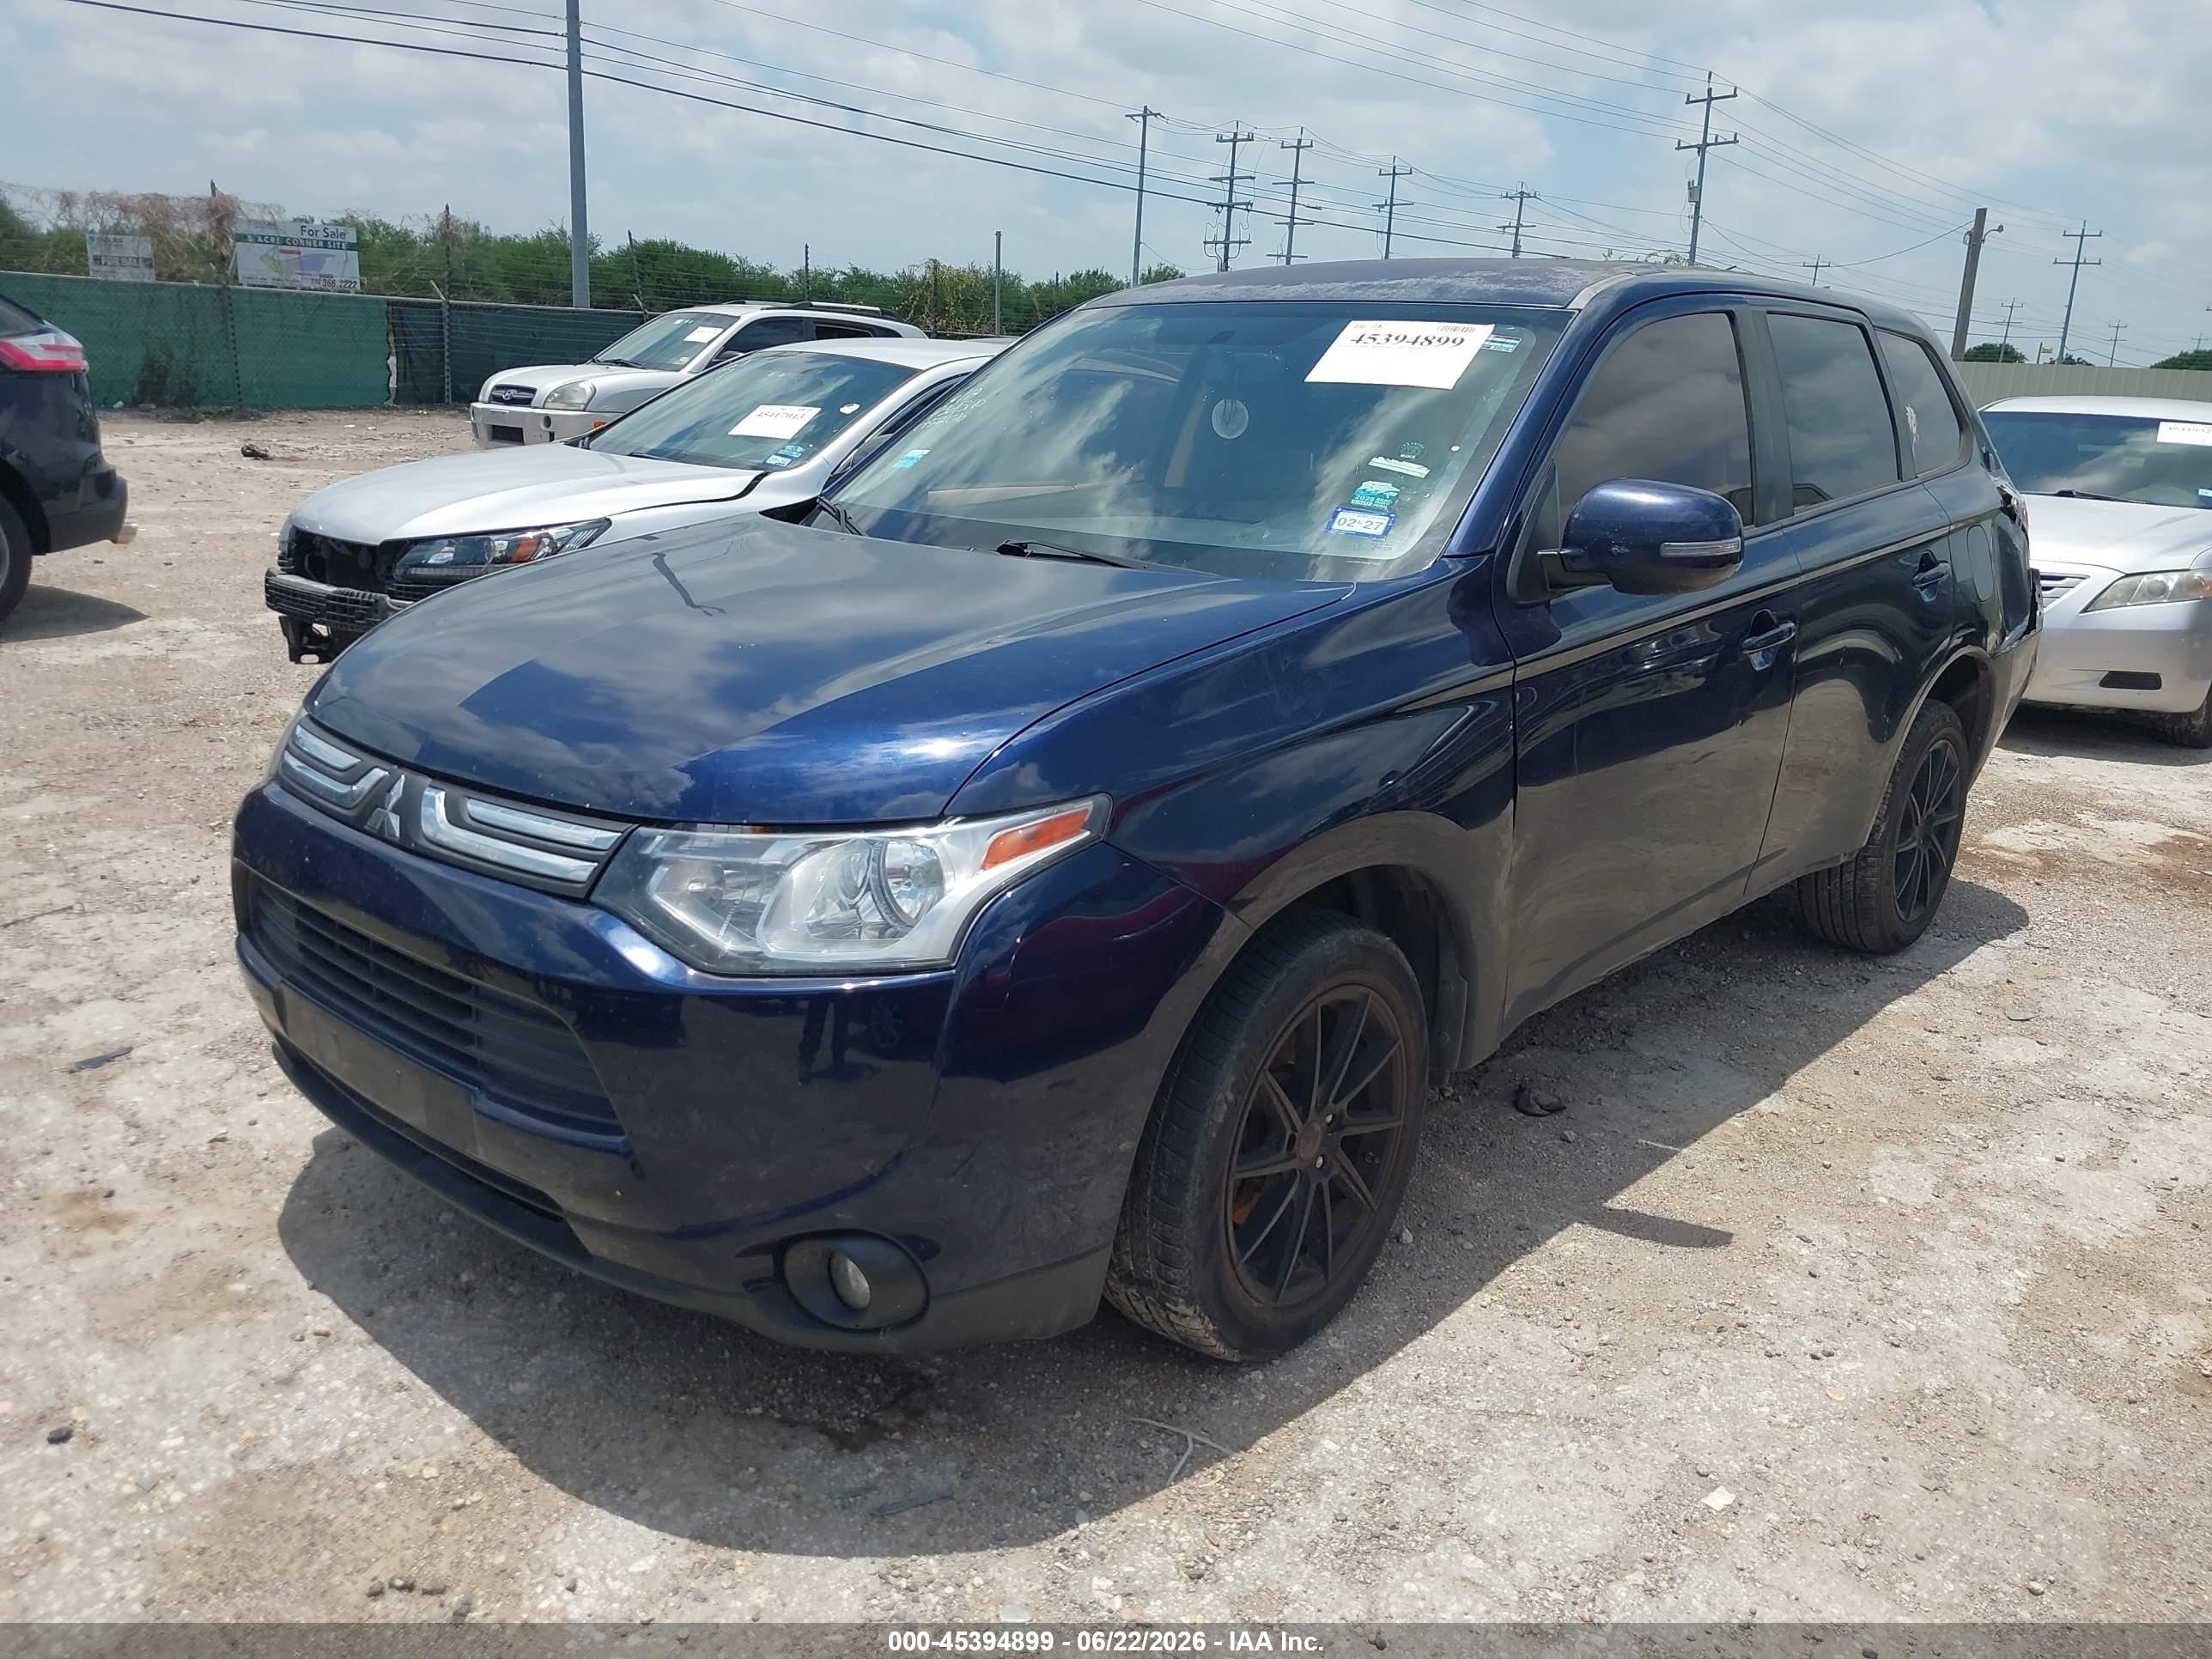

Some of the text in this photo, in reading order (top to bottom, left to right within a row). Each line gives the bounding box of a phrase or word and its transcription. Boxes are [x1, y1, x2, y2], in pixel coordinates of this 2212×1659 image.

[301, 225, 346, 240] For Sale
[285, 237, 324, 248] CORNER
[327, 240, 348, 249] SITE
[1350, 332, 1466, 348] 45394899
